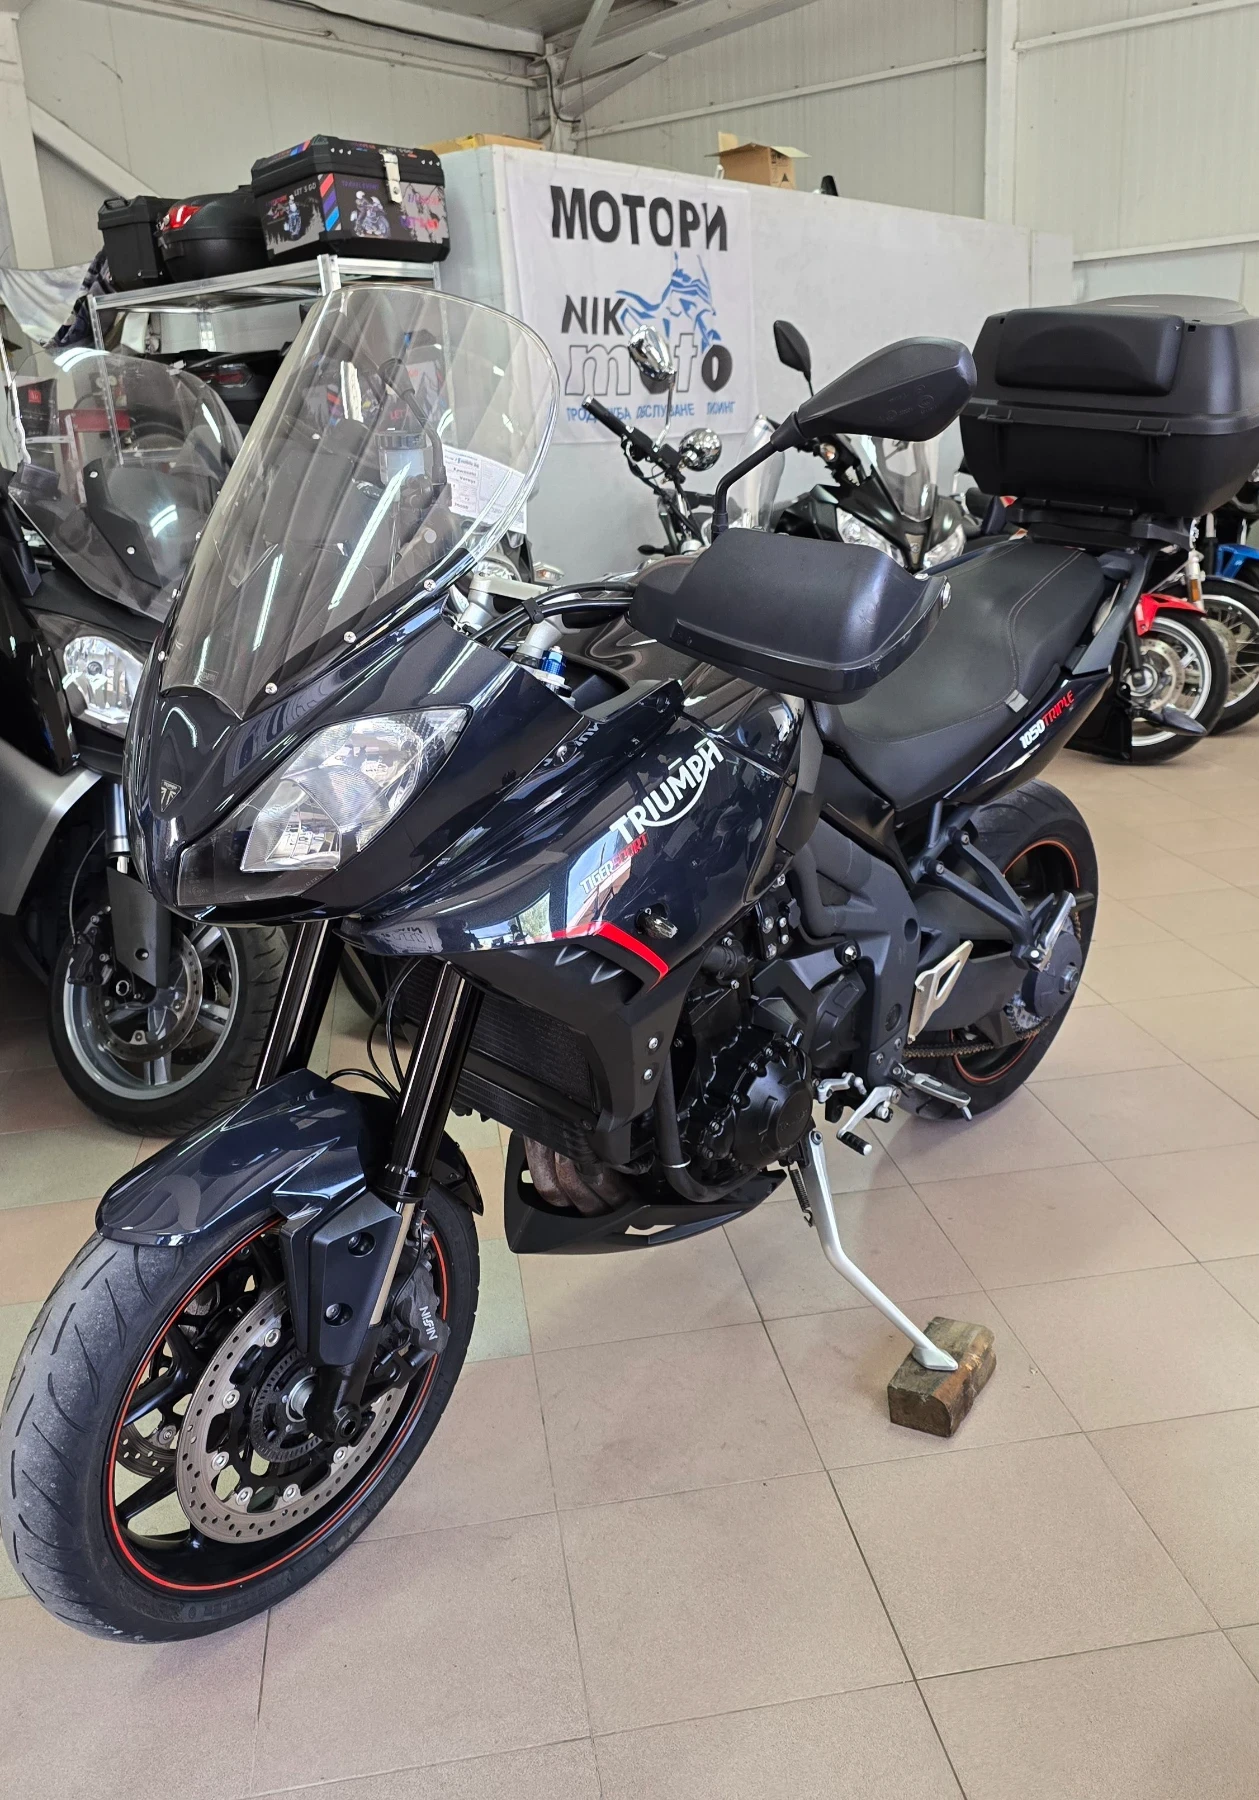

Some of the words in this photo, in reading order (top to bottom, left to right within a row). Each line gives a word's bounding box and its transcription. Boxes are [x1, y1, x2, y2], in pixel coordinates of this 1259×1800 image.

[550, 185, 728, 251] МОТОРИ
[561, 294, 626, 336] NIK
[1019, 718, 1046, 749] 1050
[1042, 689, 1075, 727] TRIPLE
[609, 737, 724, 844] TRIUMPH
[419, 1305, 438, 1341] NISSIN
